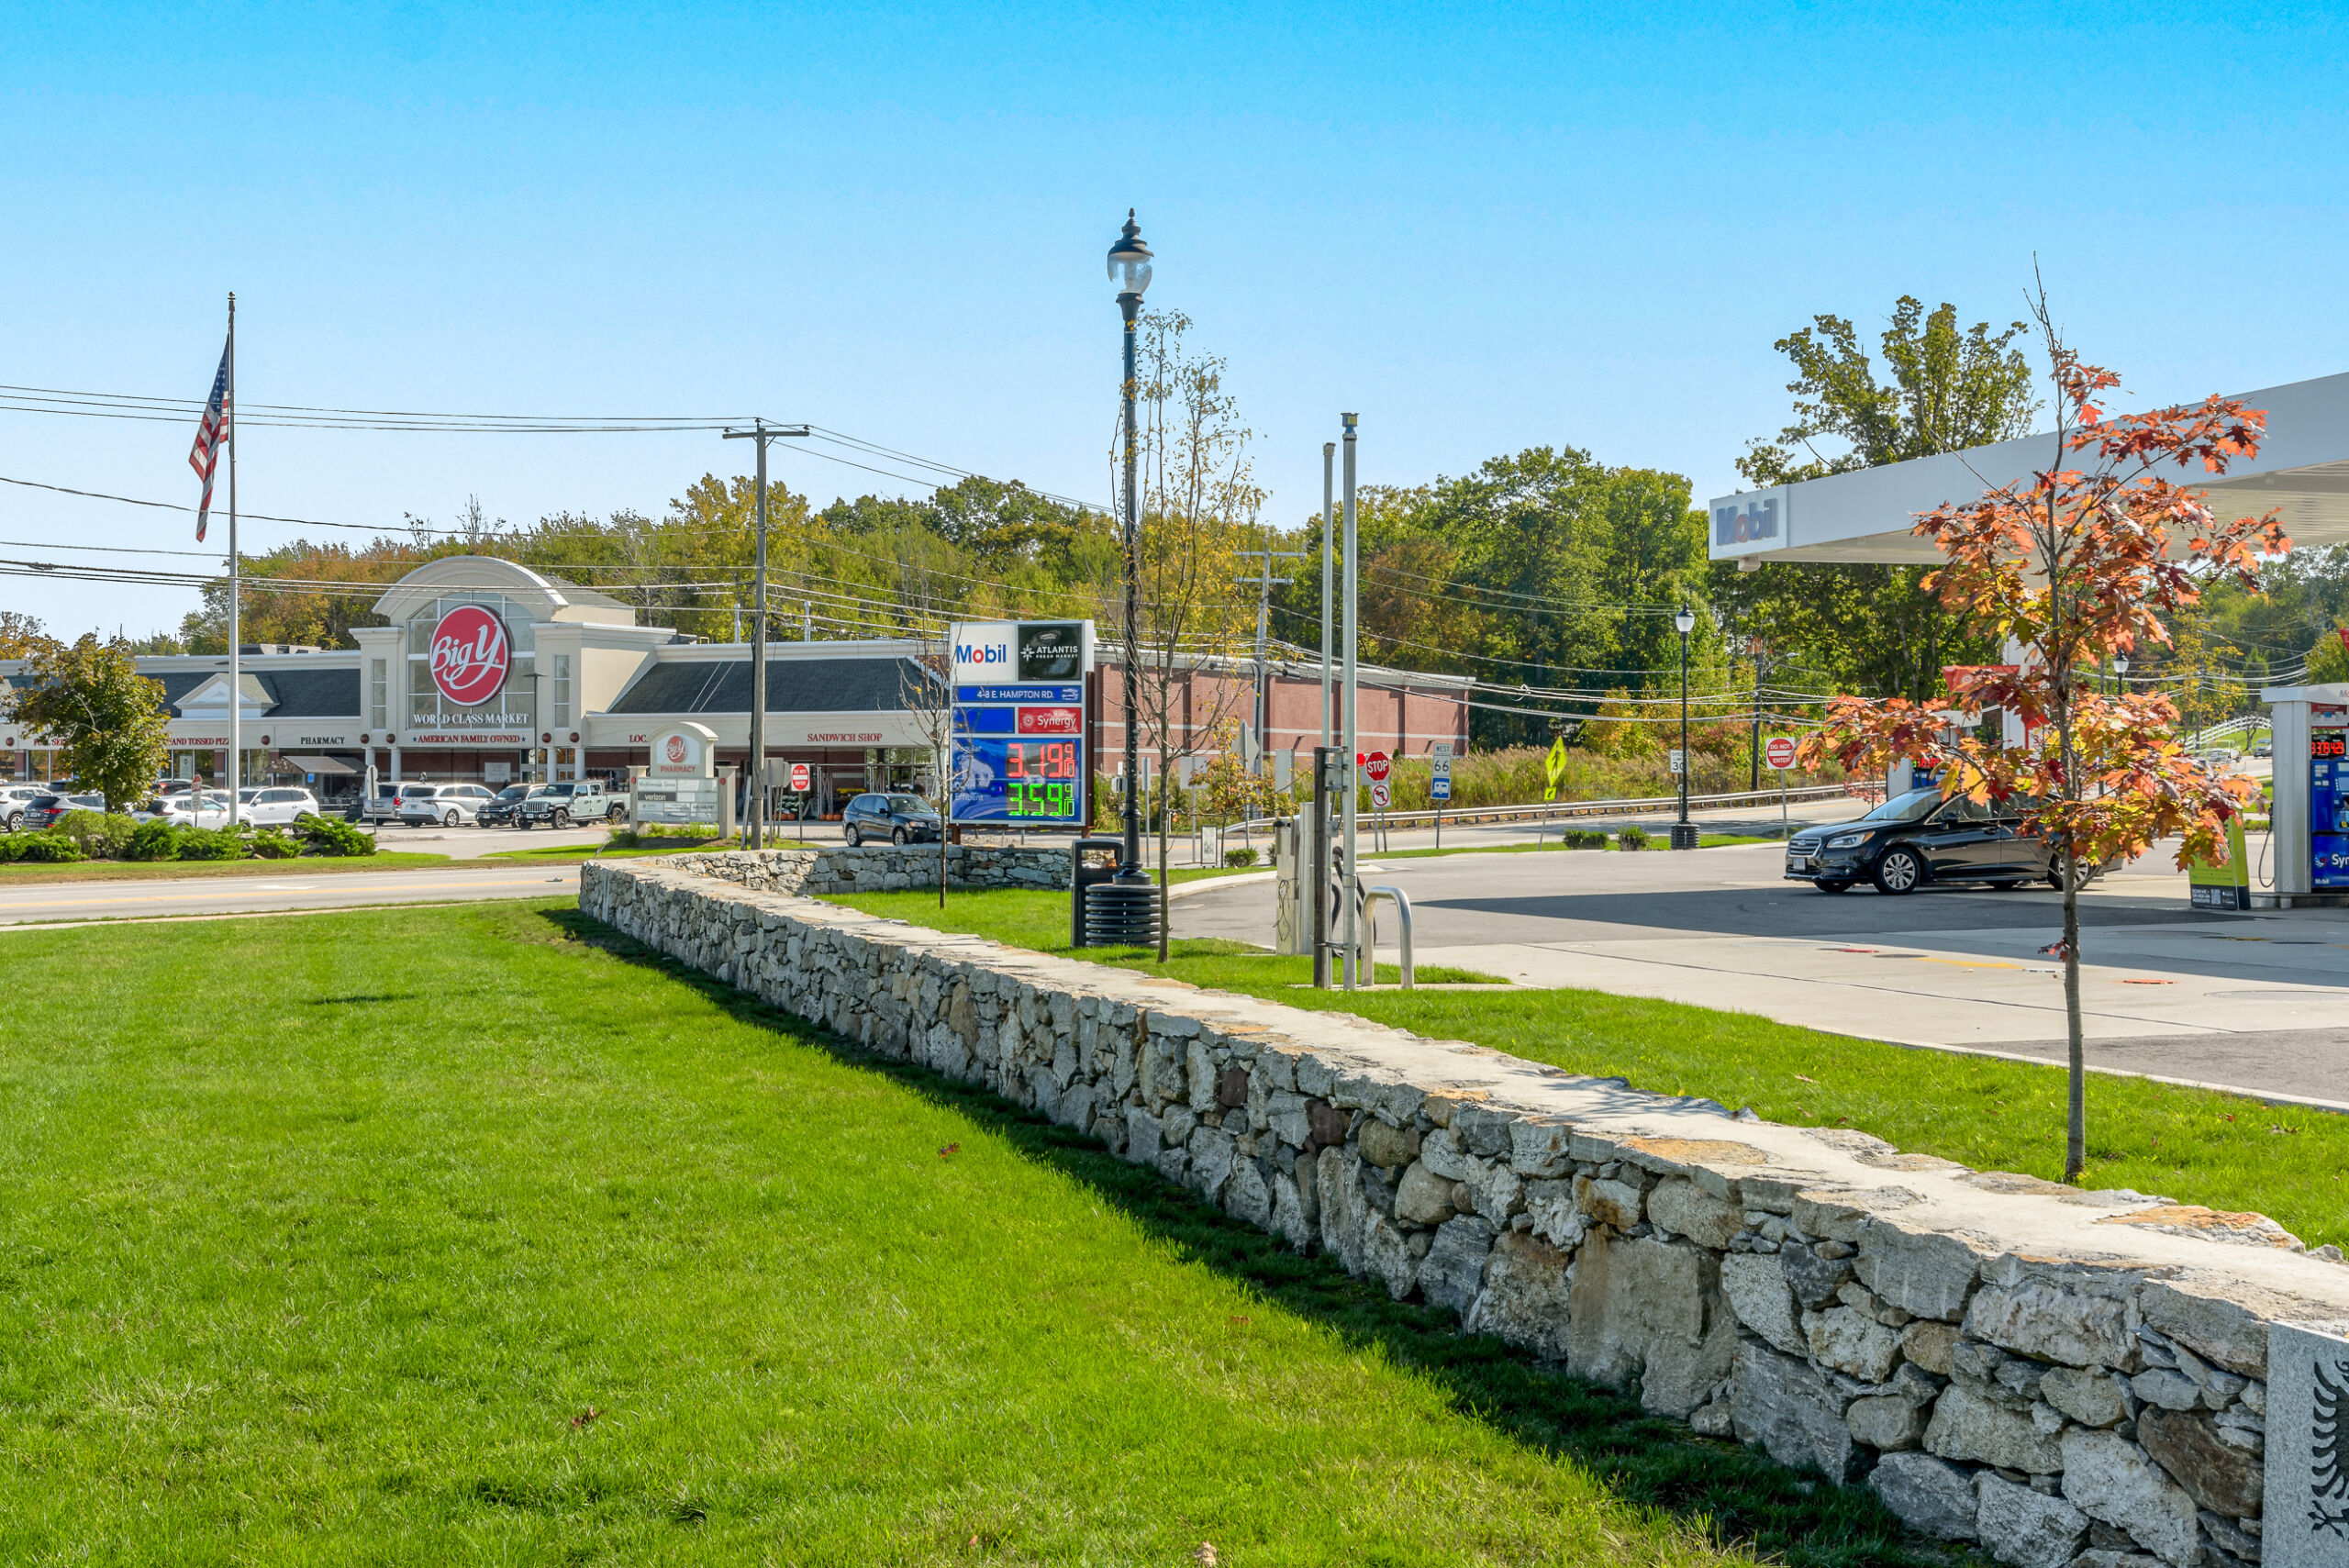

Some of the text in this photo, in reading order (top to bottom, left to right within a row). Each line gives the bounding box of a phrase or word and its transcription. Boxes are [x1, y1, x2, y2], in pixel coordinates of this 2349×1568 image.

[1716, 498, 1777, 546] Mobil
[956, 644, 1007, 663] Mobil
[1036, 645, 1078, 654] ATLANTIS
[431, 635, 474, 682] Big
[991, 690, 998, 699] E.
[999, 690, 1041, 699] HAMPTON
[1041, 689, 1054, 698] RD.
[413, 713, 529, 724] WORLD CLASS MARKET
[1037, 715, 1076, 728] Synergy
[187, 737, 215, 746] TOSSED
[300, 736, 346, 745] PHARMACY
[417, 735, 520, 743] AMERICAN FAMILY OWNED
[629, 734, 647, 743] LOC
[807, 732, 883, 742] SANDWICH SHOP
[1008, 742, 1063, 778] 3.19
[1367, 760, 1388, 773] STOP
[1434, 760, 1450, 772] 66
[644, 793, 666, 801] verizon
[1008, 783, 1063, 817] 3.59
